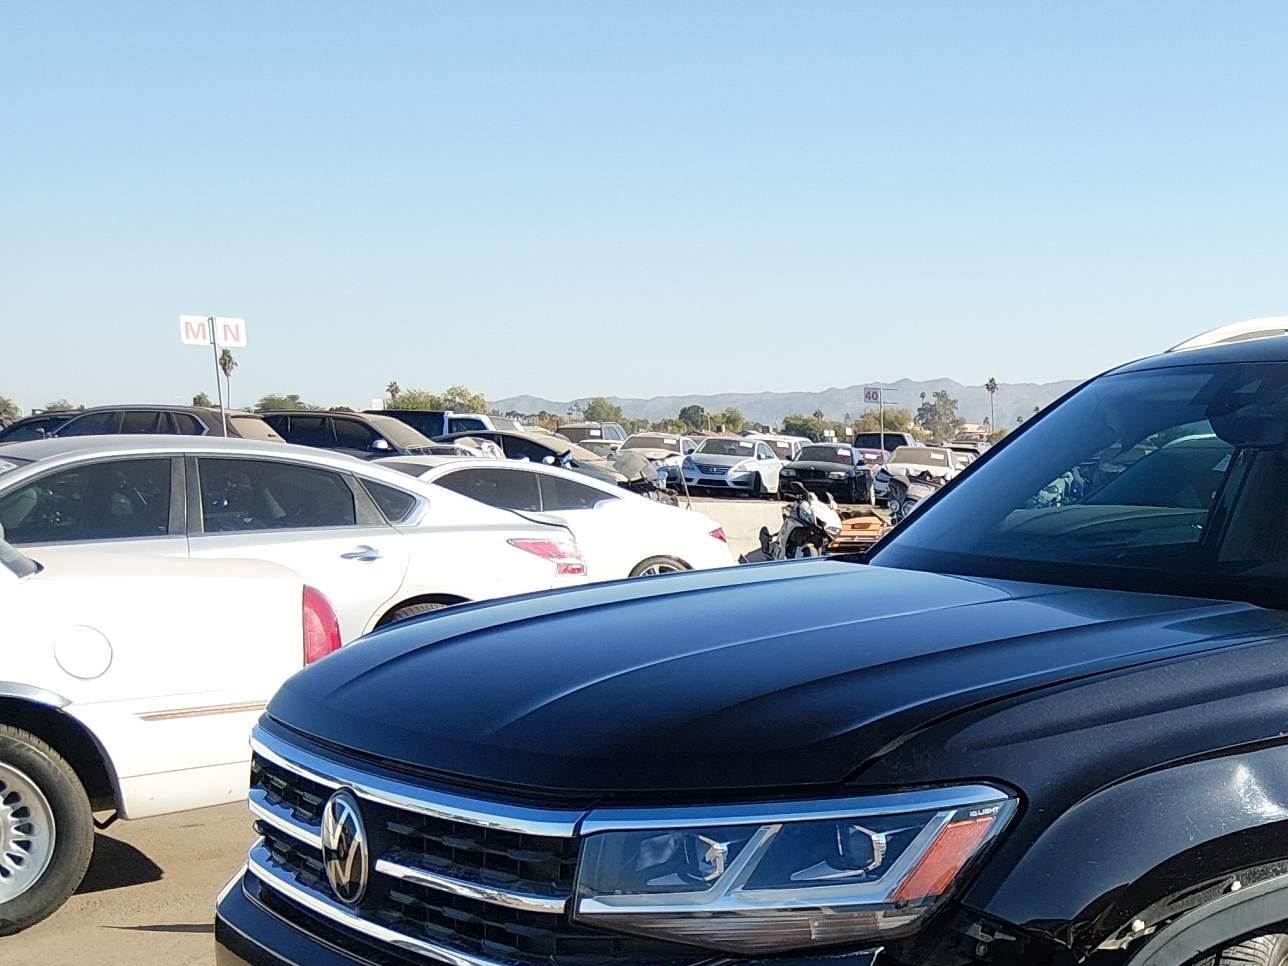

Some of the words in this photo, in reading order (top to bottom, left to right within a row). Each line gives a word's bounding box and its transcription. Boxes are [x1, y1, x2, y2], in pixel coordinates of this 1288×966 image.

[184, 320, 208, 341] M
[222, 322, 241, 343] N
[864, 391, 879, 401] 40
